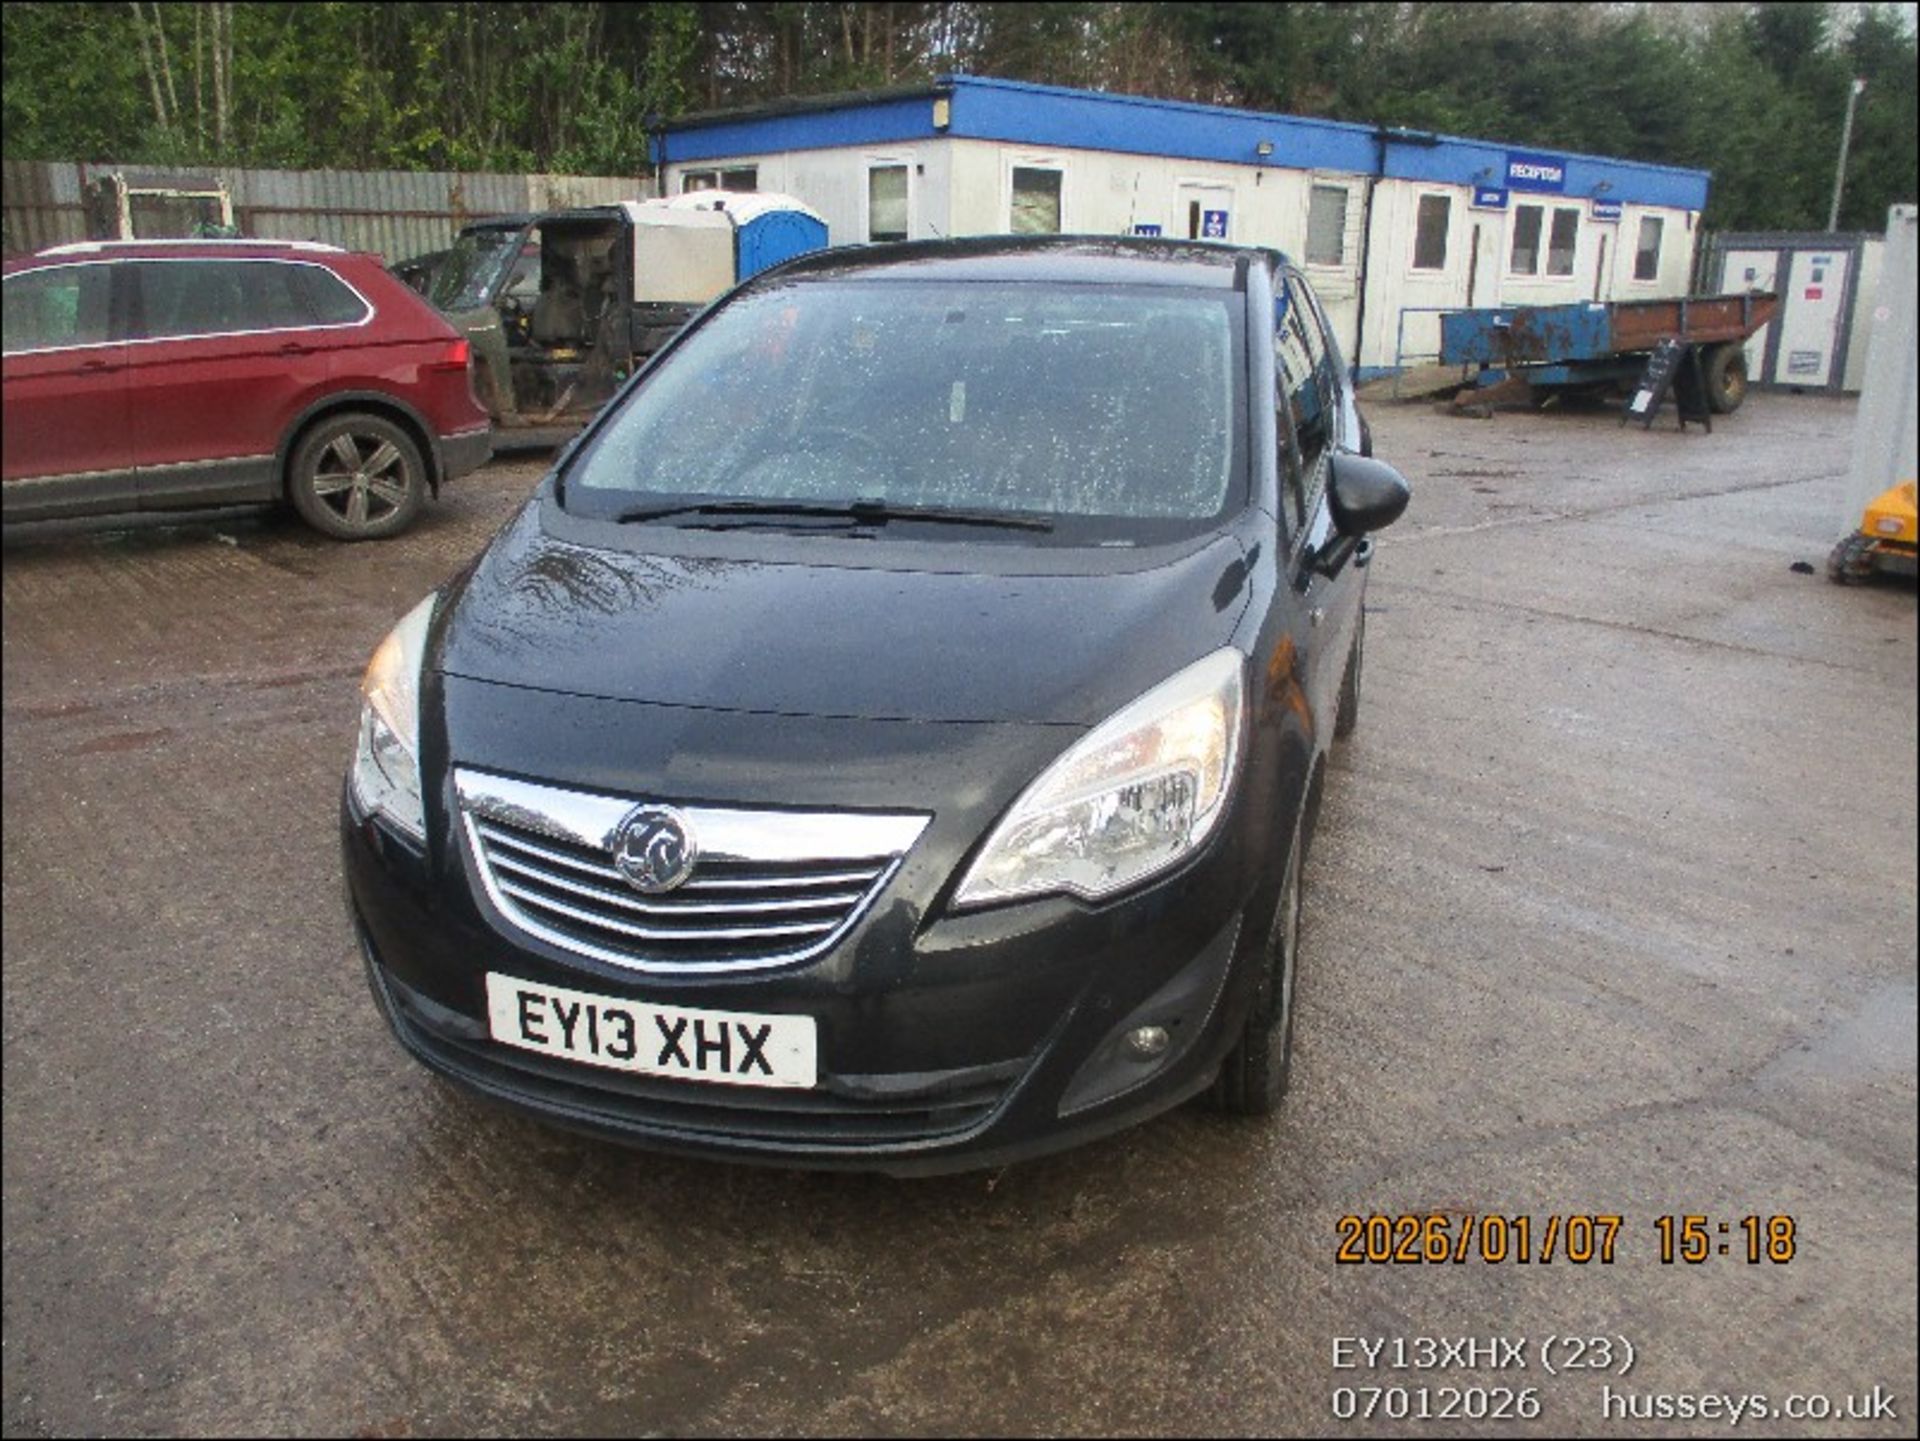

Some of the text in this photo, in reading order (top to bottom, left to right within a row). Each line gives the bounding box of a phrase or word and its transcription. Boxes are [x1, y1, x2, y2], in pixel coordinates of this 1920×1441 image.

[1509, 163, 1562, 182] RECEPTION
[517, 990, 774, 1075] EY13 XHX
